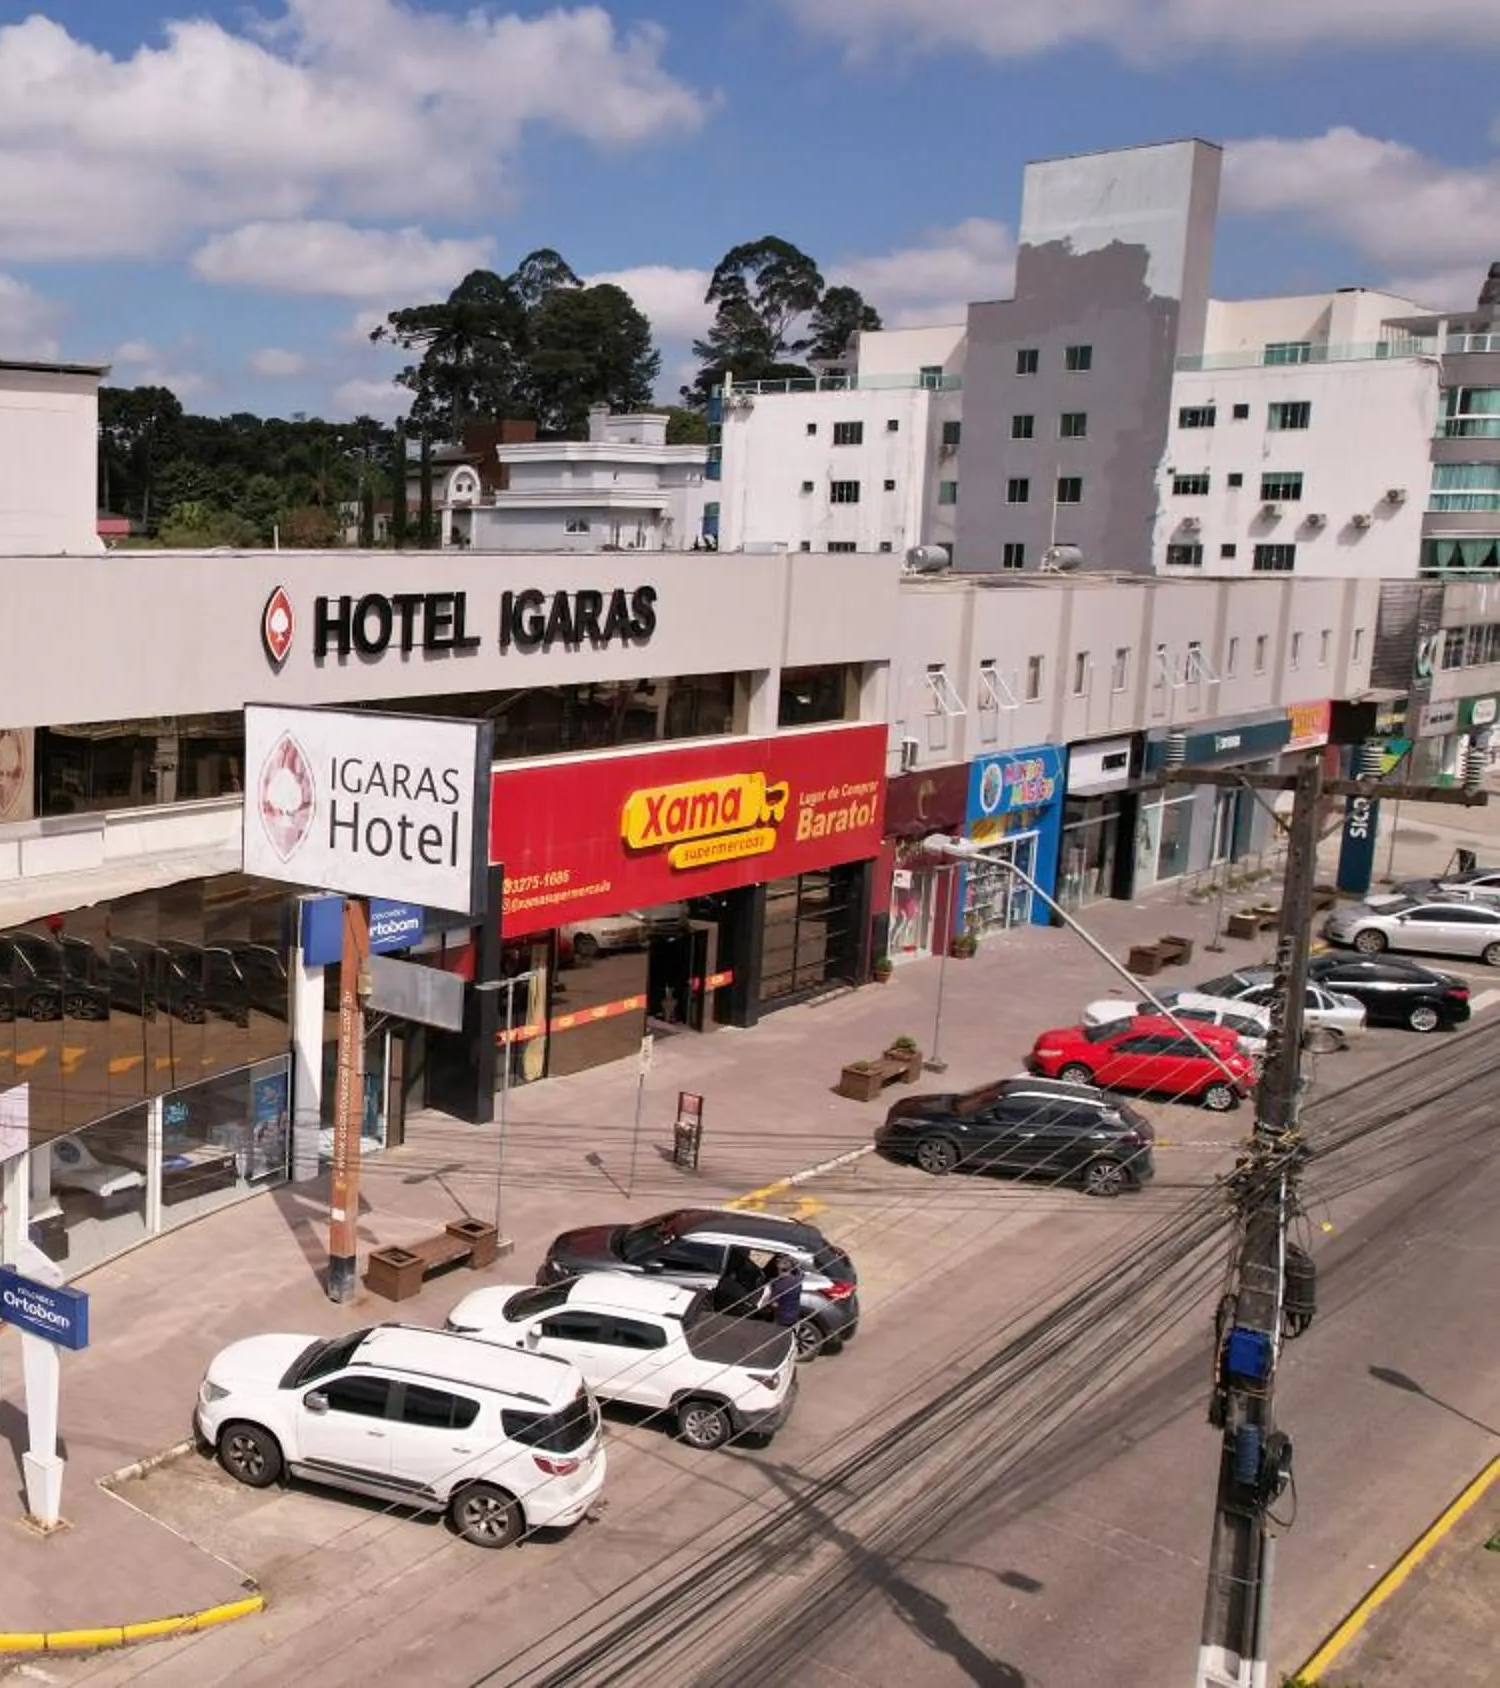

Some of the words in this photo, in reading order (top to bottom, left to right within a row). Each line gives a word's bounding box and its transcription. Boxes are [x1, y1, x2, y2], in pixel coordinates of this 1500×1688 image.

[314, 591, 481, 657] HOTEL
[499, 585, 658, 647] IGARAS
[330, 756, 460, 805] IGARAS
[799, 791, 827, 807] Lugar
[828, 785, 840, 800] de
[841, 781, 878, 797] Comprar
[329, 799, 459, 867] Hotel
[640, 787, 742, 840] Xama
[796, 794, 878, 840] Barato!
[368, 918, 419, 938] rtobom
[3, 1290, 70, 1329] Ortobom
